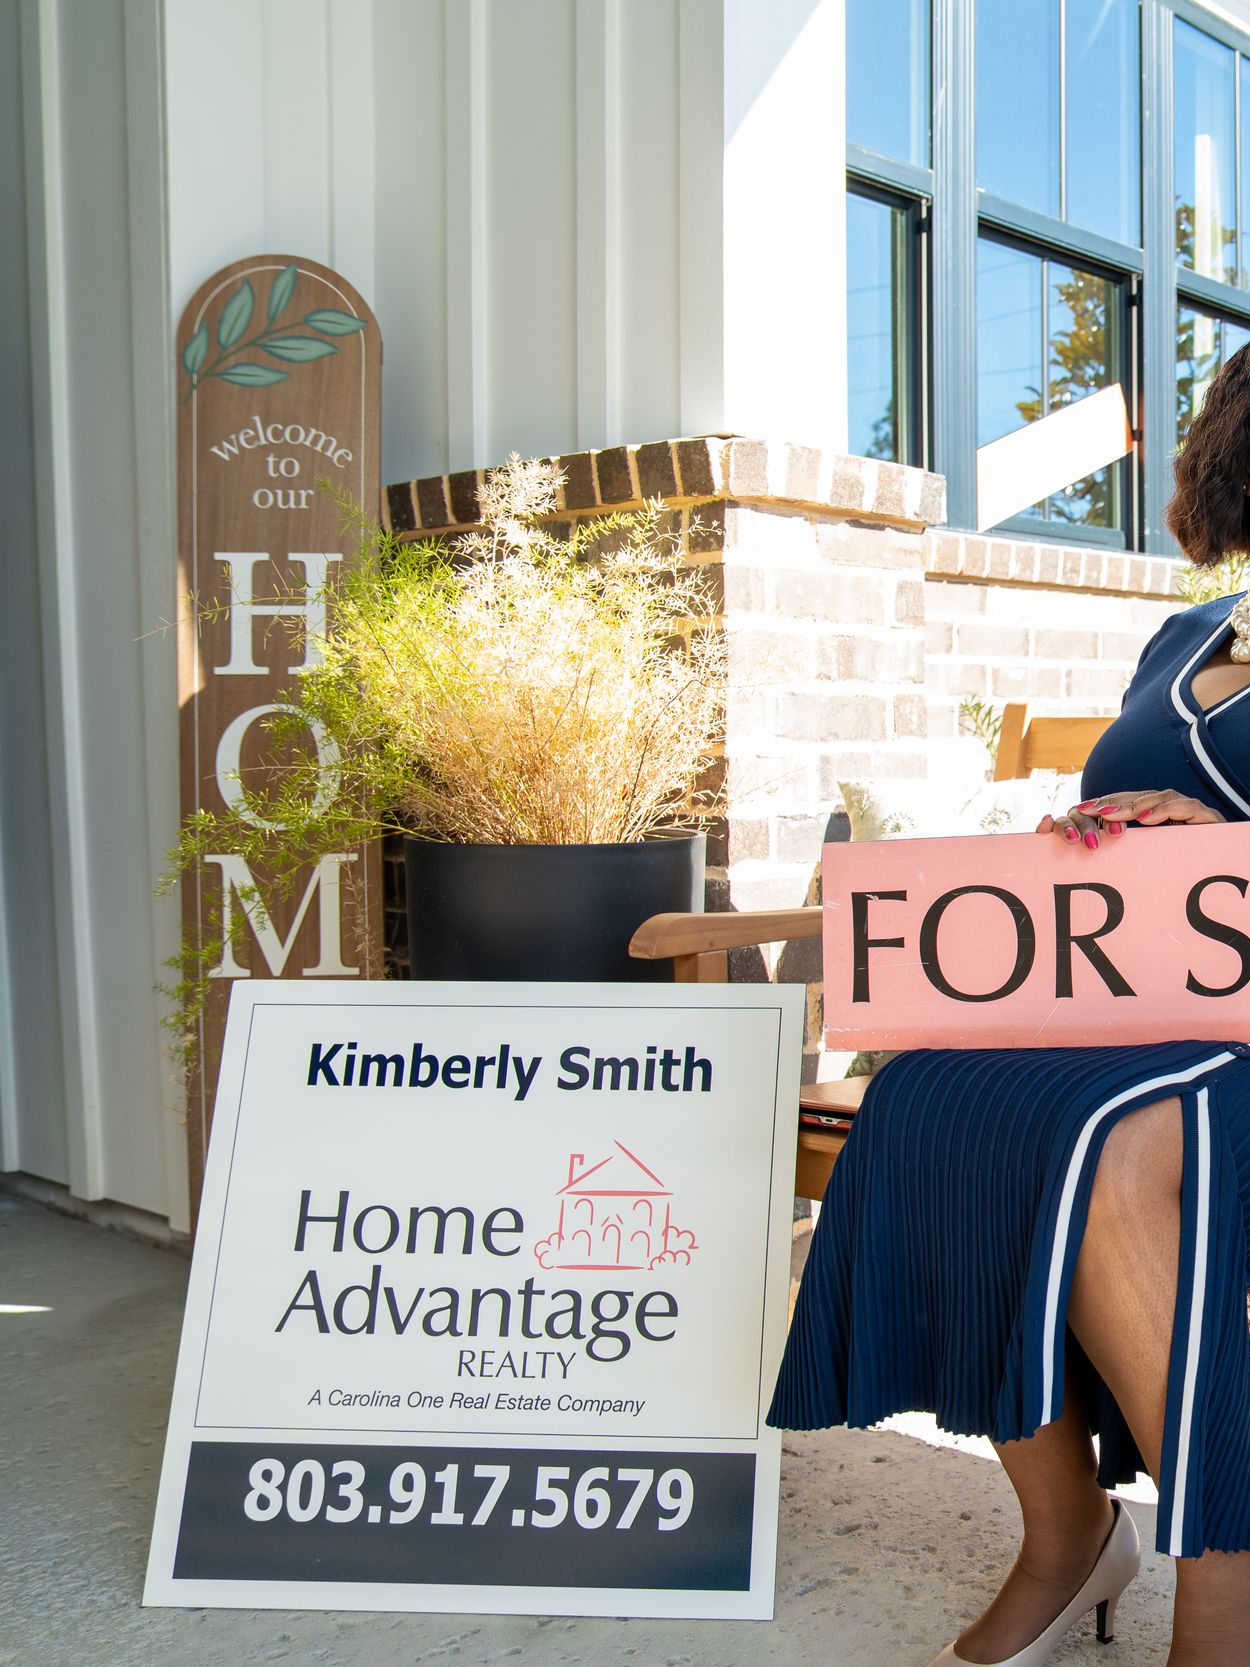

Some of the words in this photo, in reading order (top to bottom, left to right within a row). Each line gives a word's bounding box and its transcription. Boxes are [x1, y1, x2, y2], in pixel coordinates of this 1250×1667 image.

[209, 416, 353, 469] welcome
[267, 454, 300, 478] to
[252, 488, 314, 510] our
[204, 552, 360, 978] HOM
[851, 882, 1138, 1003] FOR
[306, 1042, 543, 1101] Kimberly
[556, 1045, 713, 1092] Smith
[293, 1189, 524, 1257] Home
[274, 1265, 679, 1363] Advantage
[457, 1349, 577, 1379] REALTY
[307, 1389, 322, 1406] A
[328, 1389, 401, 1408] Carolina
[407, 1391, 444, 1409] One
[449, 1392, 490, 1410] Real
[494, 1393, 551, 1411] Estate
[557, 1395, 646, 1417] Company
[243, 1457, 695, 1531] 803.917.5679
